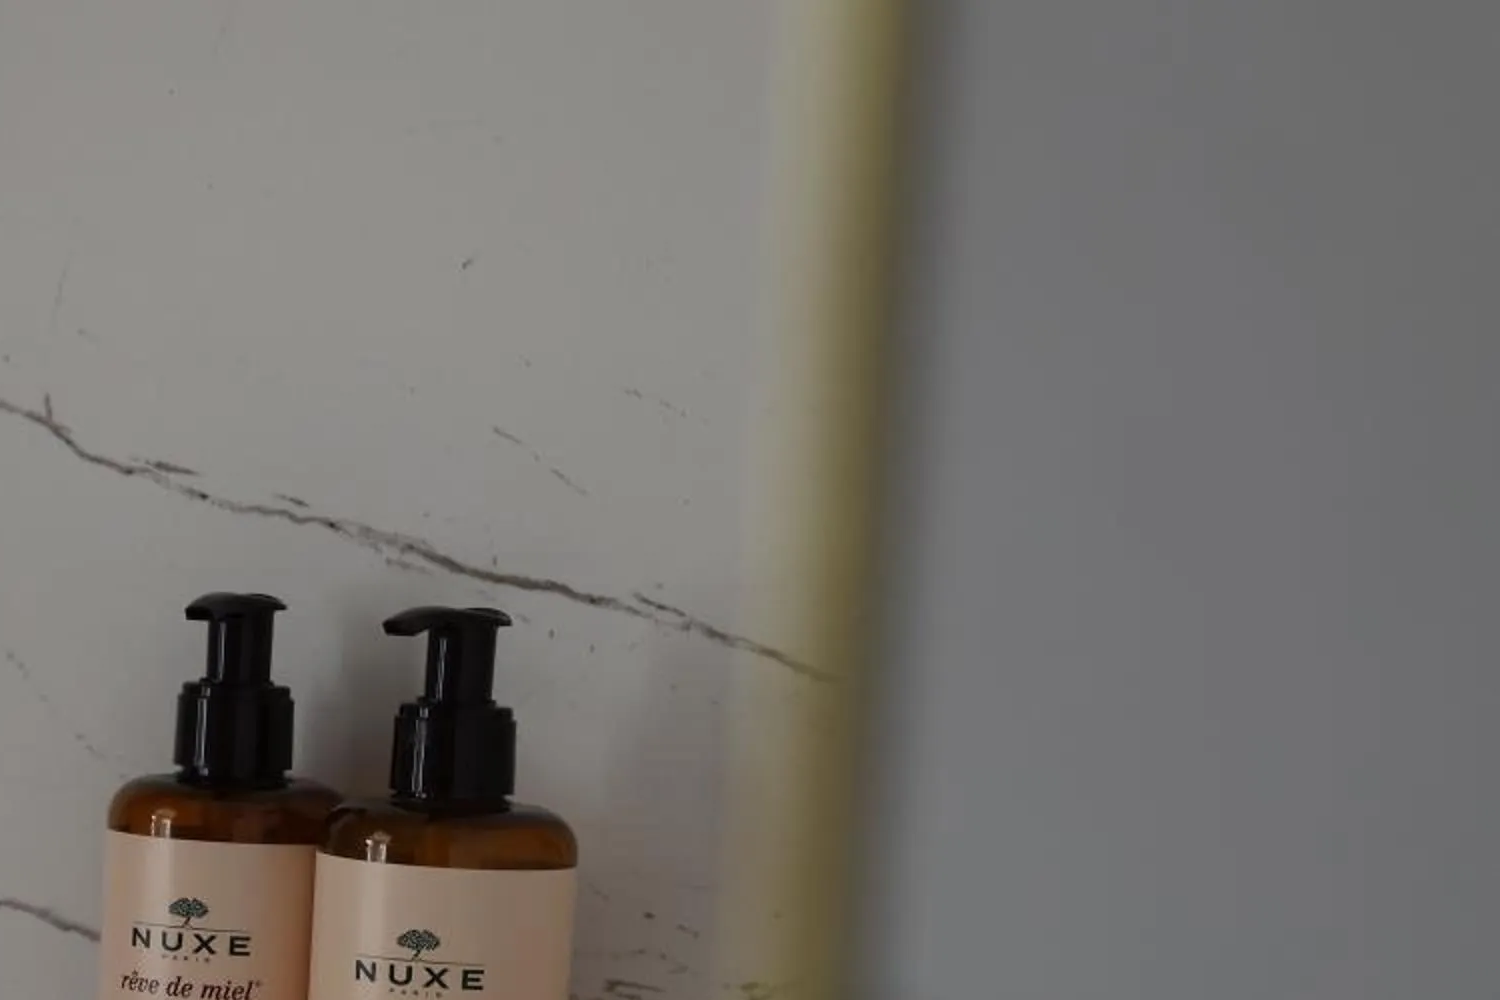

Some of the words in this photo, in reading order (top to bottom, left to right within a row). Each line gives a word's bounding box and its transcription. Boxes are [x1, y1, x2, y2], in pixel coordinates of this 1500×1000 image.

[130, 927, 252, 957] NUXE
[120, 971, 160, 995] rêve
[165, 976, 194, 998] de
[355, 959, 485, 991] NUXE
